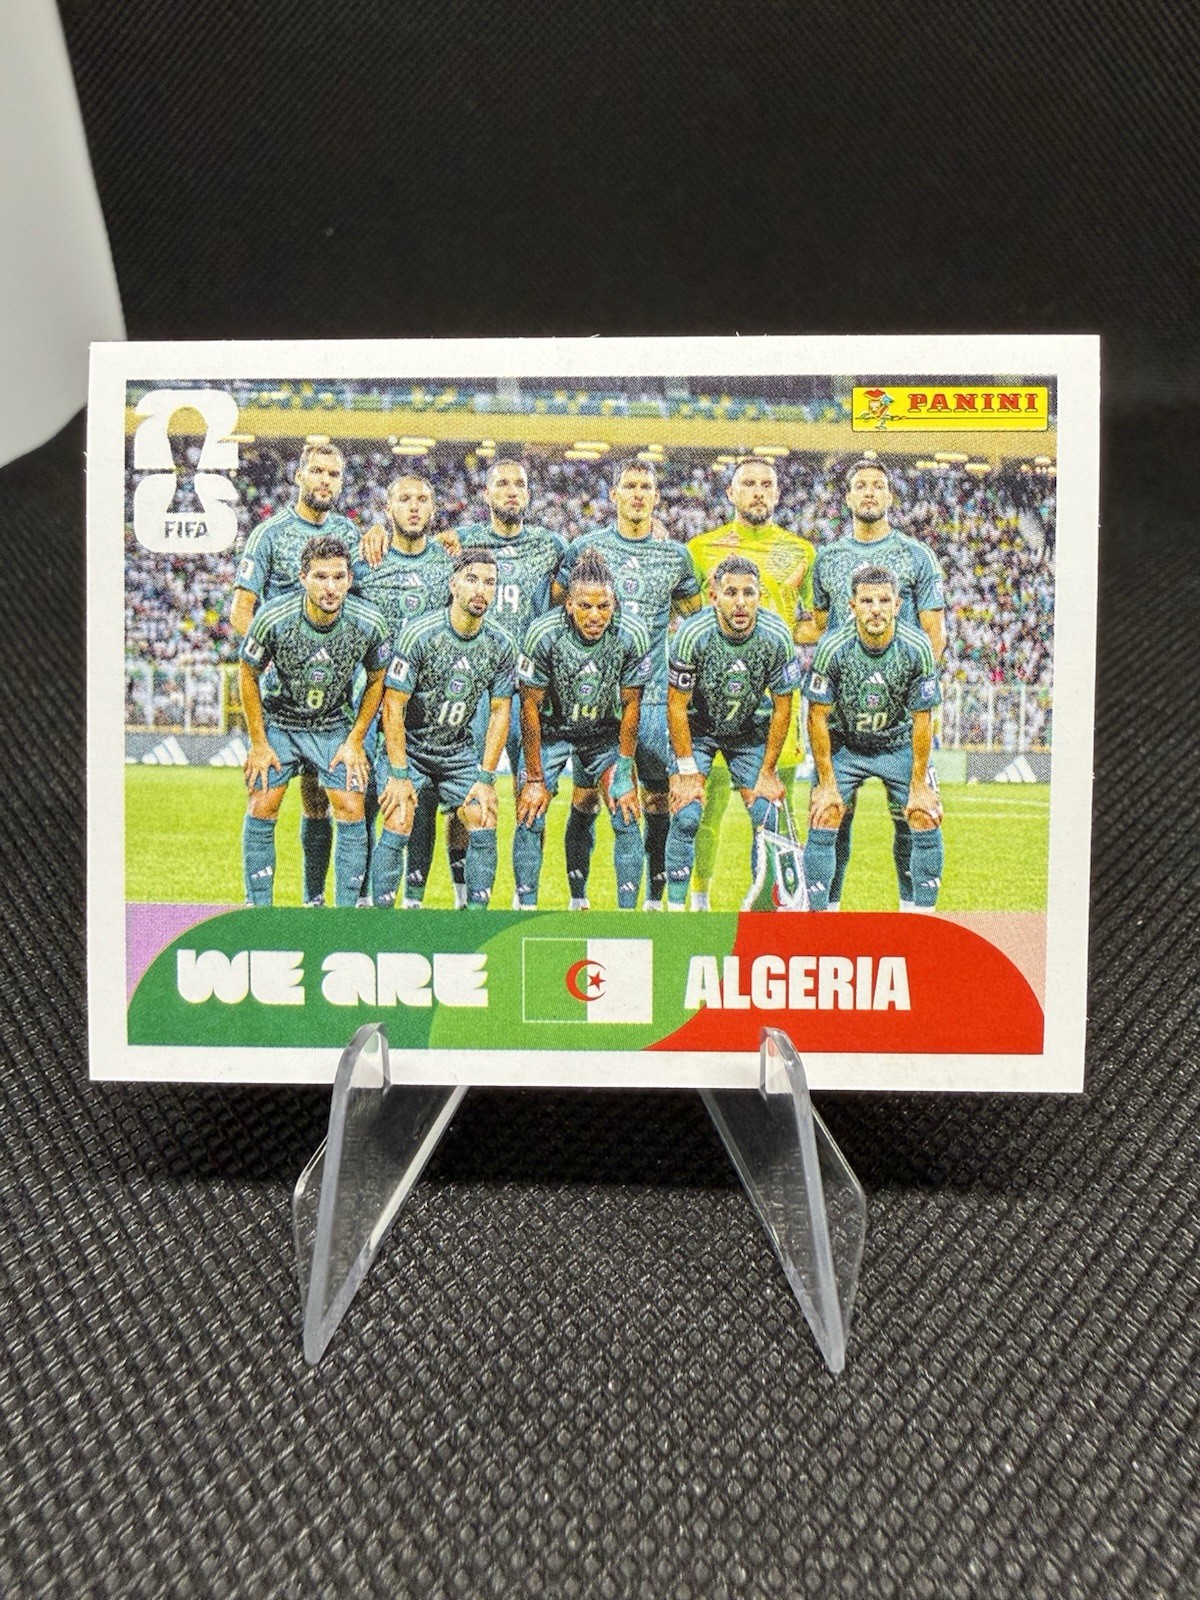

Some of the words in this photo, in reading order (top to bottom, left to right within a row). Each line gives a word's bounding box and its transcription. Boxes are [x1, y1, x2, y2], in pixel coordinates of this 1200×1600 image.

[907, 393, 1039, 412] PANINI
[164, 521, 208, 538] FIFA
[497, 585, 519, 613] 19
[678, 672, 692, 688] C
[306, 689, 325, 709] 8
[437, 700, 467, 726] 18
[571, 702, 598, 721] 14
[725, 701, 741, 721] 7
[856, 711, 888, 732] 20
[177, 949, 305, 1004] WE
[321, 952, 489, 1007] ARE
[684, 955, 911, 1010] ALGERIA
